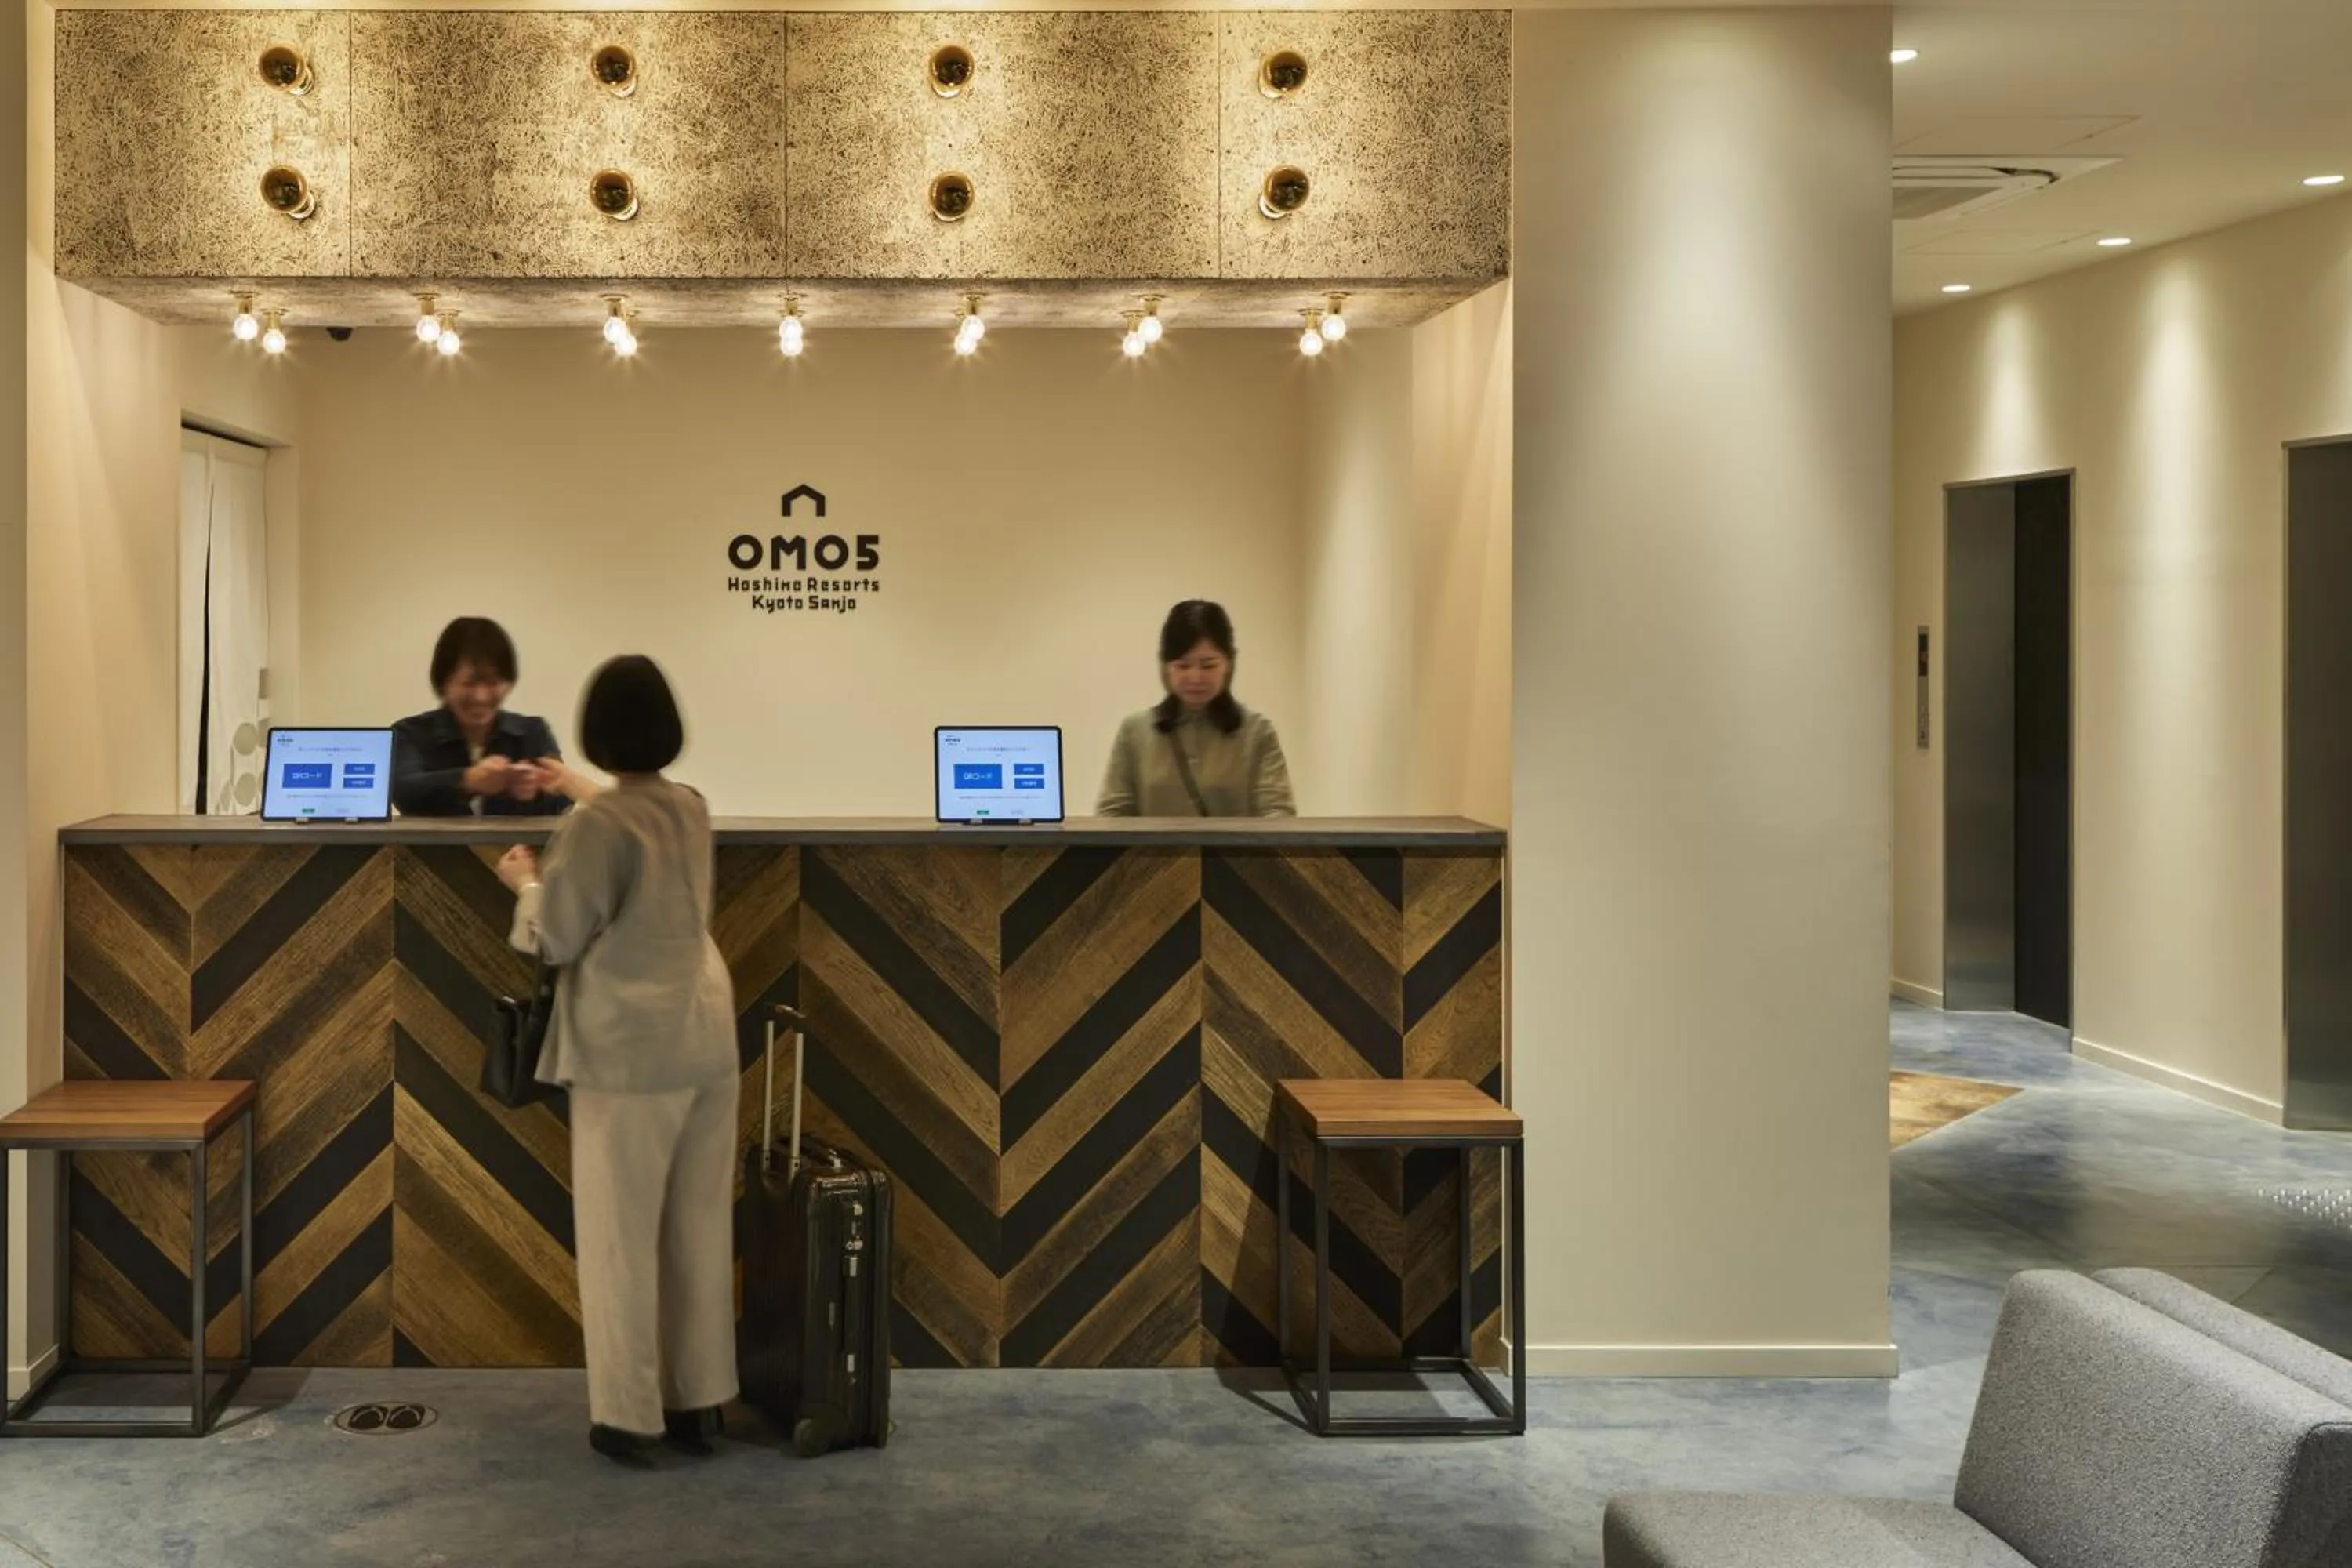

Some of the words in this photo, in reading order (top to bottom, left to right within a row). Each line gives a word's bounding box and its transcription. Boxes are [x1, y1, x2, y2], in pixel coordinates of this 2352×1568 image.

[728, 534, 880, 571] OMO5
[728, 577, 802, 591] Hoshino
[807, 577, 880, 591] Resorts
[752, 595, 804, 613] Kyoto
[808, 595, 856, 614] Sanjo
